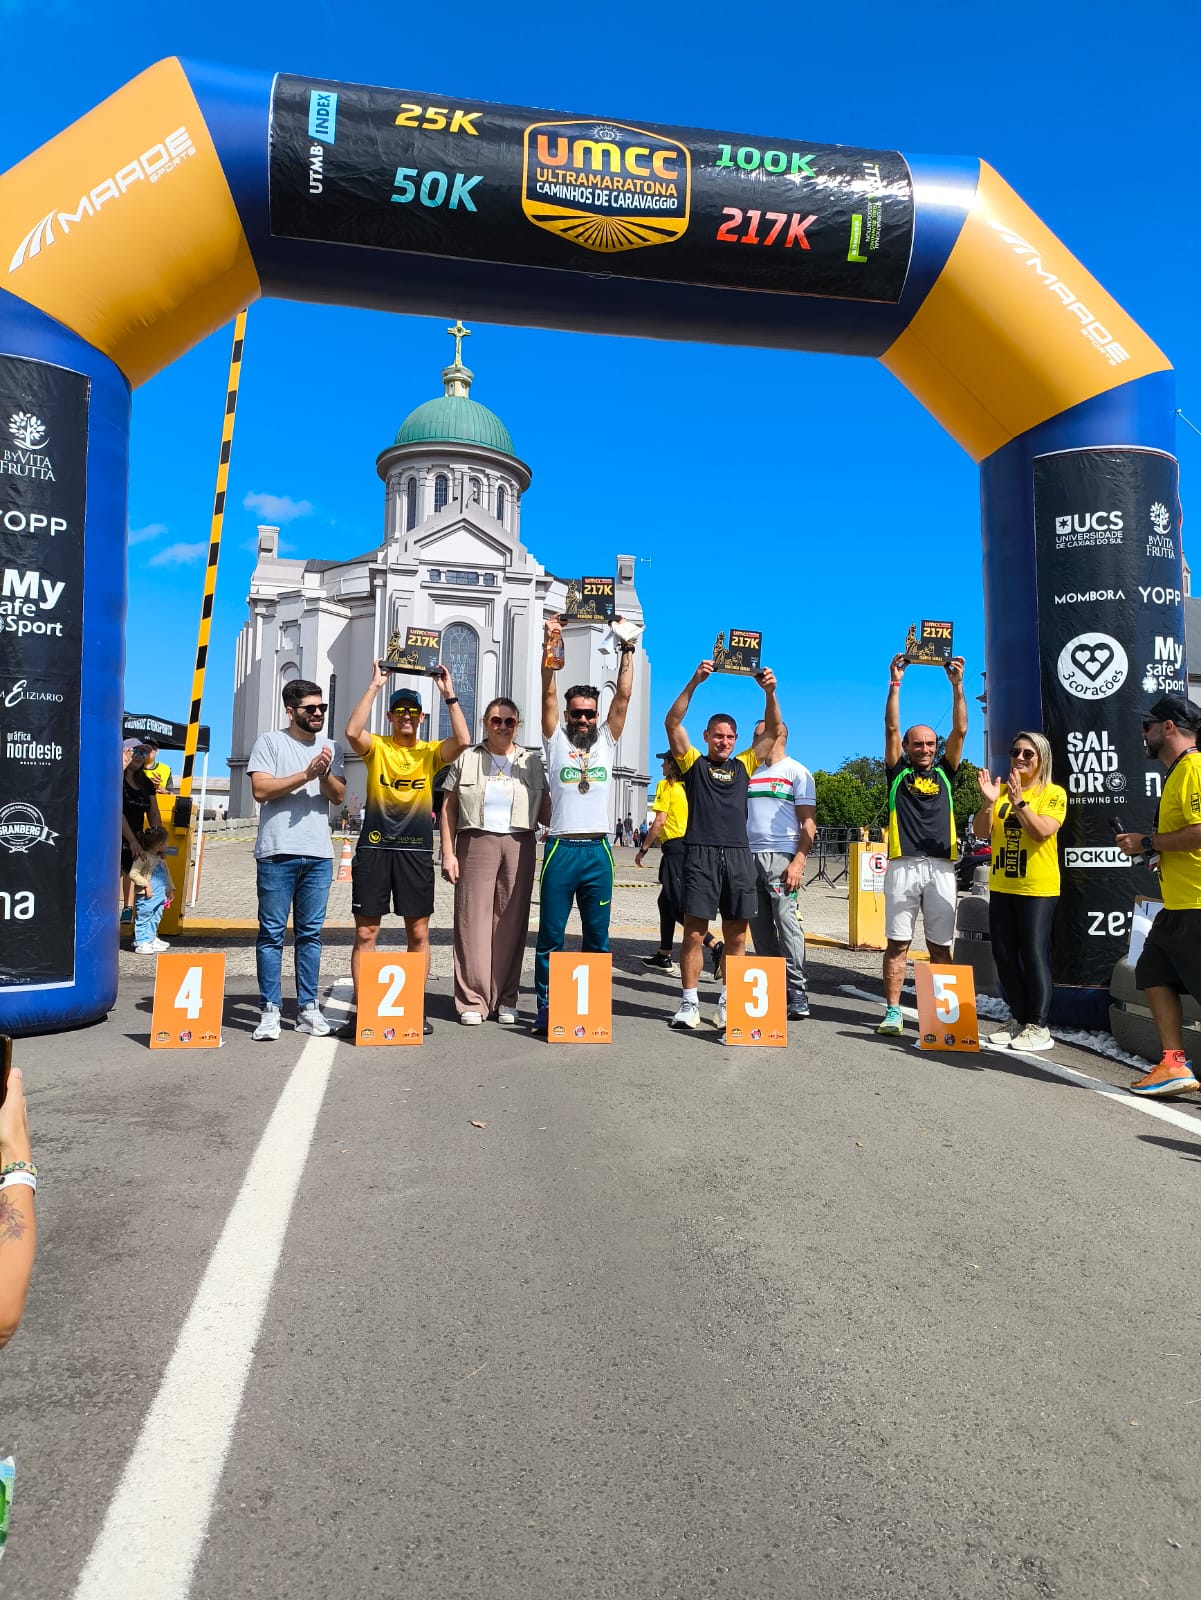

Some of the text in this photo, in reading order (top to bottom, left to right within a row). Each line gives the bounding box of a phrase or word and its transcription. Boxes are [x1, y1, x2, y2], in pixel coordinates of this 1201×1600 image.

[394, 103, 484, 136] 25K
[310, 94, 331, 194] UTMB INDEX
[149, 146, 196, 184] SPORTS
[716, 144, 817, 177] 100K
[390, 166, 485, 212] 50K
[536, 168, 678, 197] ULTRAMARATONA
[536, 182, 678, 210] CAMINHOS DE CARAVAGGIO
[716, 206, 818, 250] 217K
[0, 460, 56, 482] FRUTTA
[0, 510, 68, 536] OPP
[1074, 510, 1124, 532] UCS
[1056, 530, 1123, 544] UNIVERSIDADE
[1146, 545, 1175, 560] FRUTTA
[2, 568, 66, 610] My
[584, 584, 614, 596] 217K
[1138, 586, 1181, 606] YOPP
[0, 598, 36, 617] afe
[5, 615, 63, 637] Sport
[923, 627, 952, 639] 217K
[408, 634, 440, 648] 217K
[731, 636, 760, 649] 217K
[1154, 636, 1183, 669] My
[1146, 662, 1174, 676] safe
[1062, 669, 1124, 696] 3 corações
[1158, 676, 1185, 693] Sport
[6, 741, 62, 760] nordeste
[1067, 731, 1116, 751] SAL
[1067, 751, 1119, 773] VAD
[1068, 773, 1104, 793] OR
[1113, 796, 1128, 804] CO.
[1006, 841, 1019, 872] CREW
[1087, 911, 1132, 936] ze
[174, 966, 203, 1020] 4
[377, 964, 406, 1017] 2
[572, 964, 590, 1015] 1
[743, 968, 769, 1018] 3
[932, 974, 960, 1024] 5
